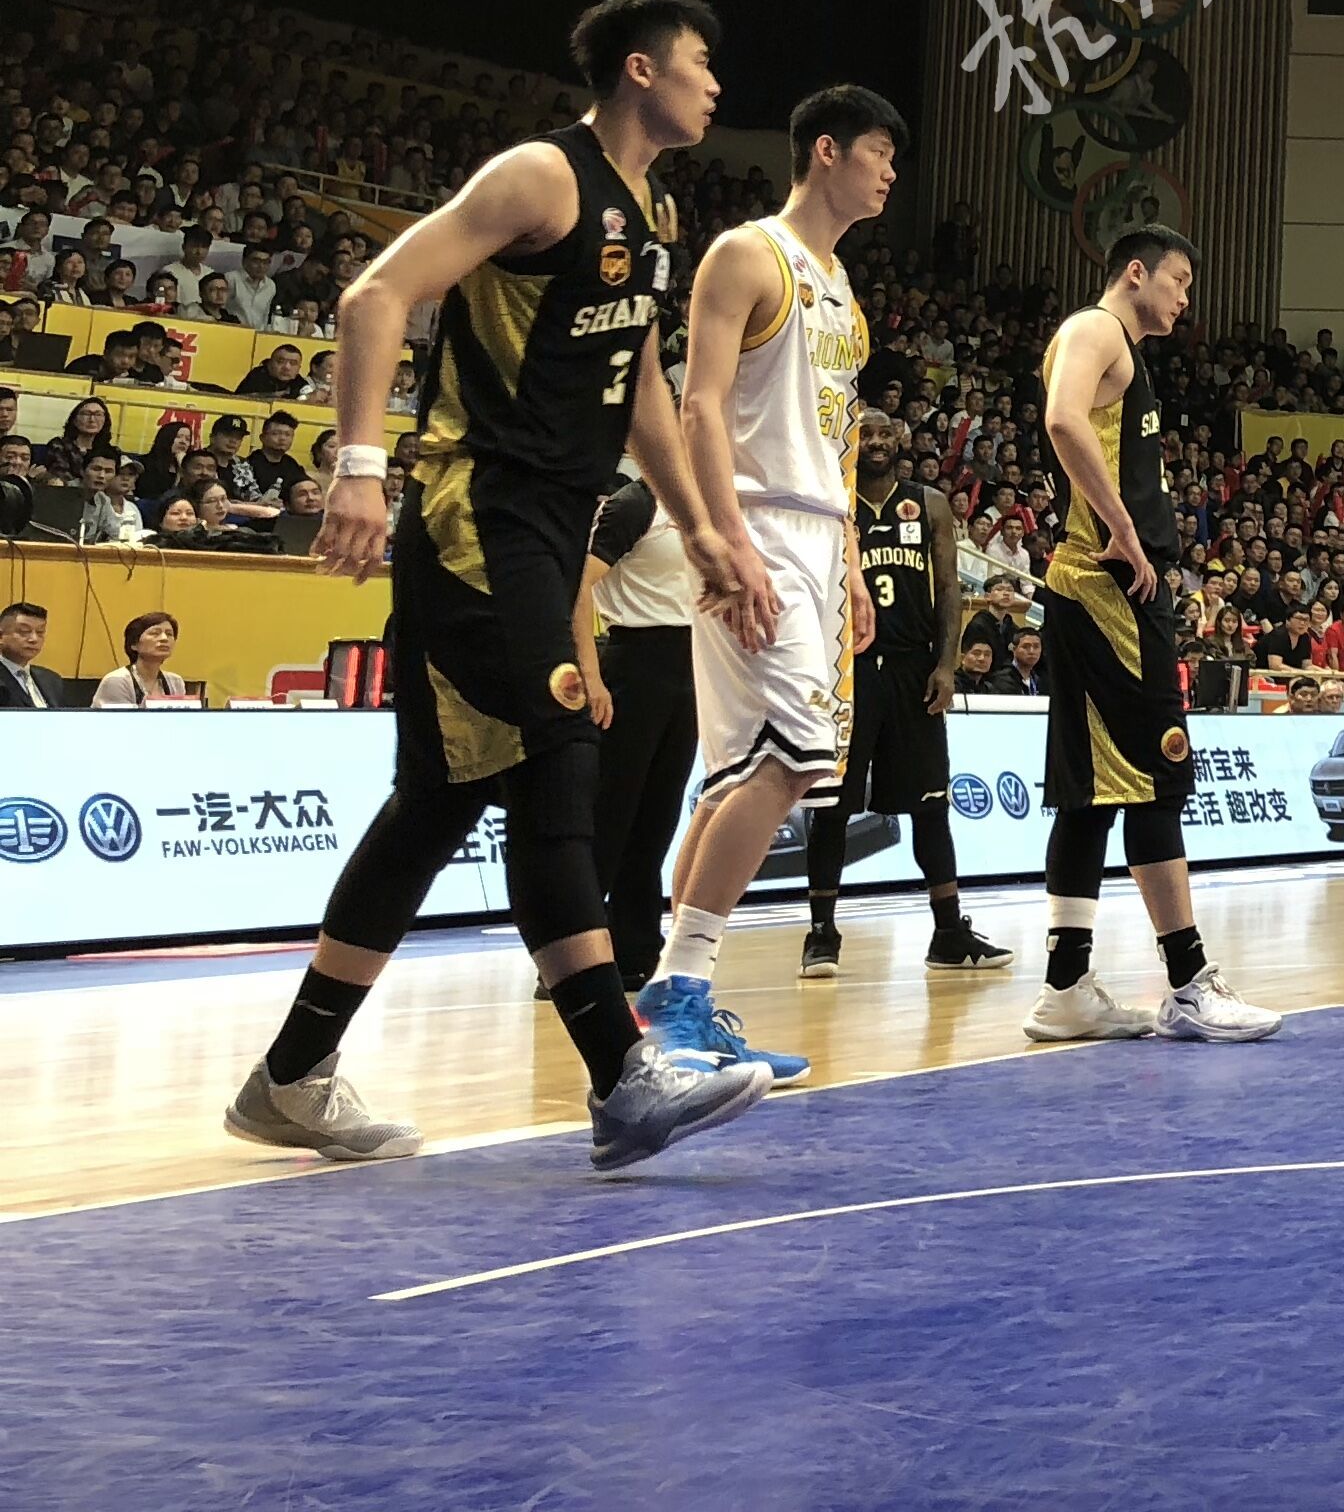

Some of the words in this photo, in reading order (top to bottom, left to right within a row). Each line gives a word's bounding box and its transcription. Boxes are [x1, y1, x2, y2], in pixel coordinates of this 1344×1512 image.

[818, 386, 845, 439] 21
[875, 574, 896, 607] 3
[162, 833, 339, 859] FAW-VOLKSWAGEN
